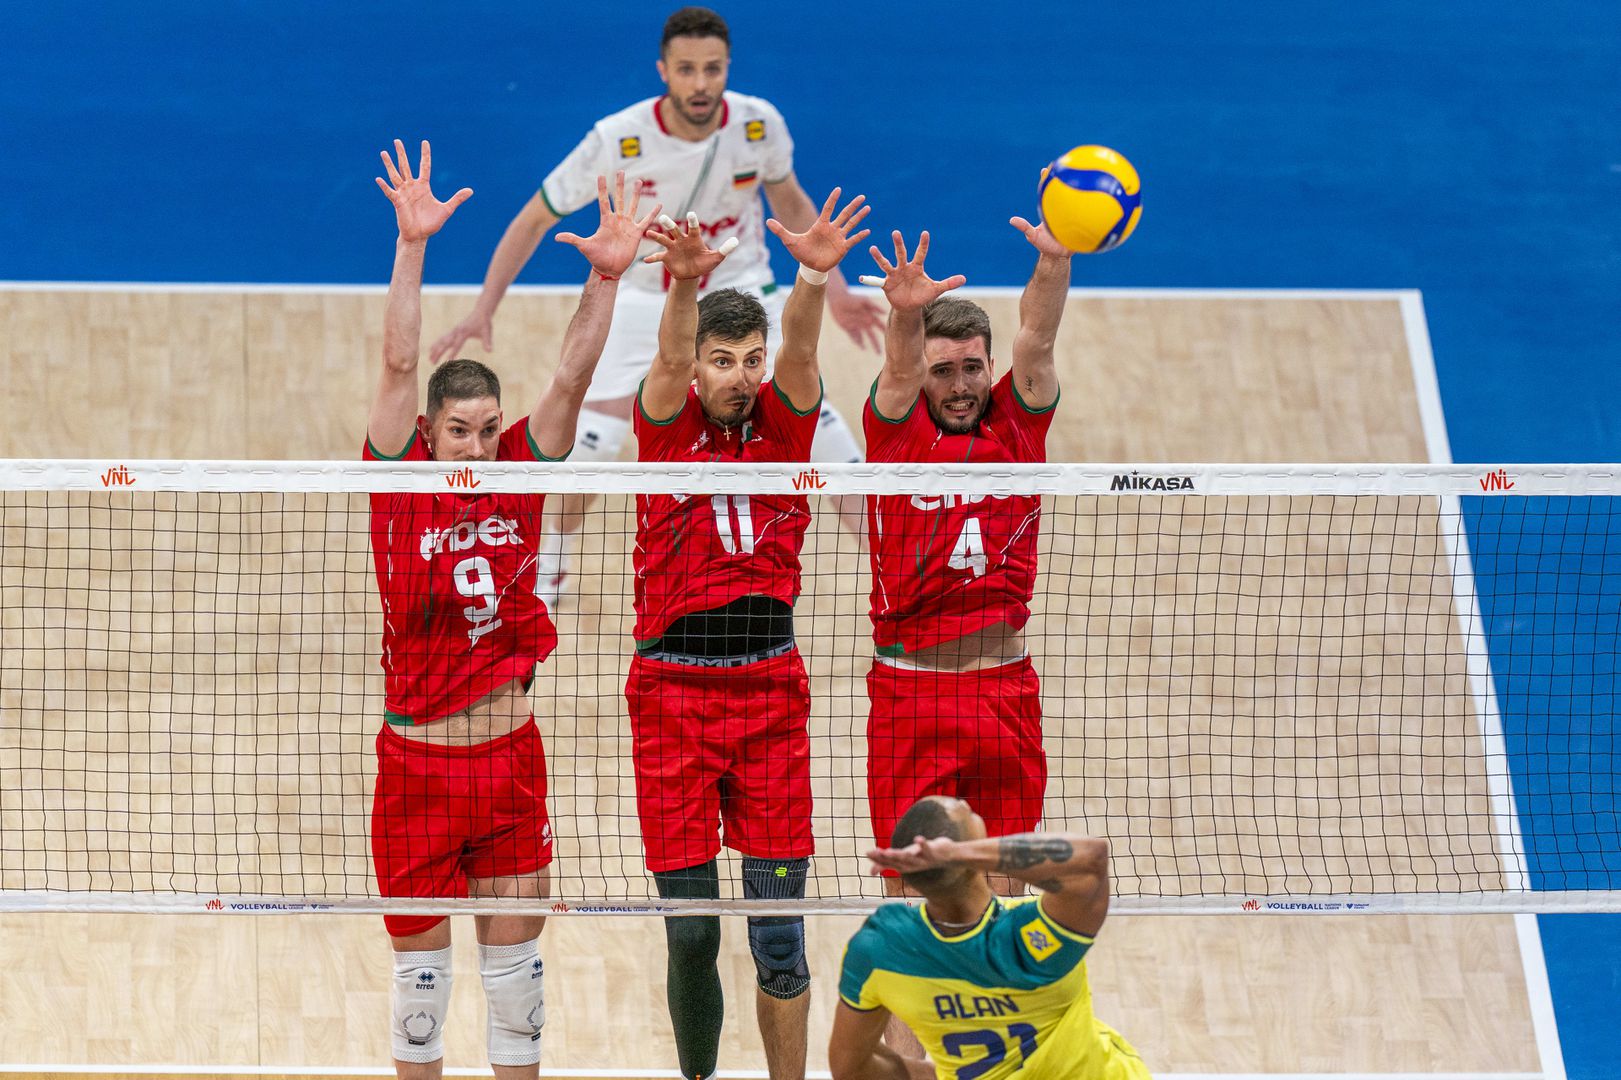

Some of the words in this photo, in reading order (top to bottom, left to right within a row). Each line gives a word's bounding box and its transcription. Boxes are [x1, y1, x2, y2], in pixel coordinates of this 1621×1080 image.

[101, 465, 136, 487] VNL
[445, 467, 481, 489] VNL
[792, 468, 827, 490] VNL
[1110, 469, 1195, 491] MIKASA
[1479, 468, 1515, 491] VNL
[711, 494, 754, 555] 11
[948, 517, 988, 579] 4
[453, 556, 498, 624] 9
[205, 898, 226, 910] VNL
[550, 902, 571, 913] VNL
[1241, 899, 1261, 911] VNL
[1266, 902, 1323, 910] VOLLEYBALL
[934, 993, 1021, 1020] ALAN
[942, 1022, 1039, 1080] 21
